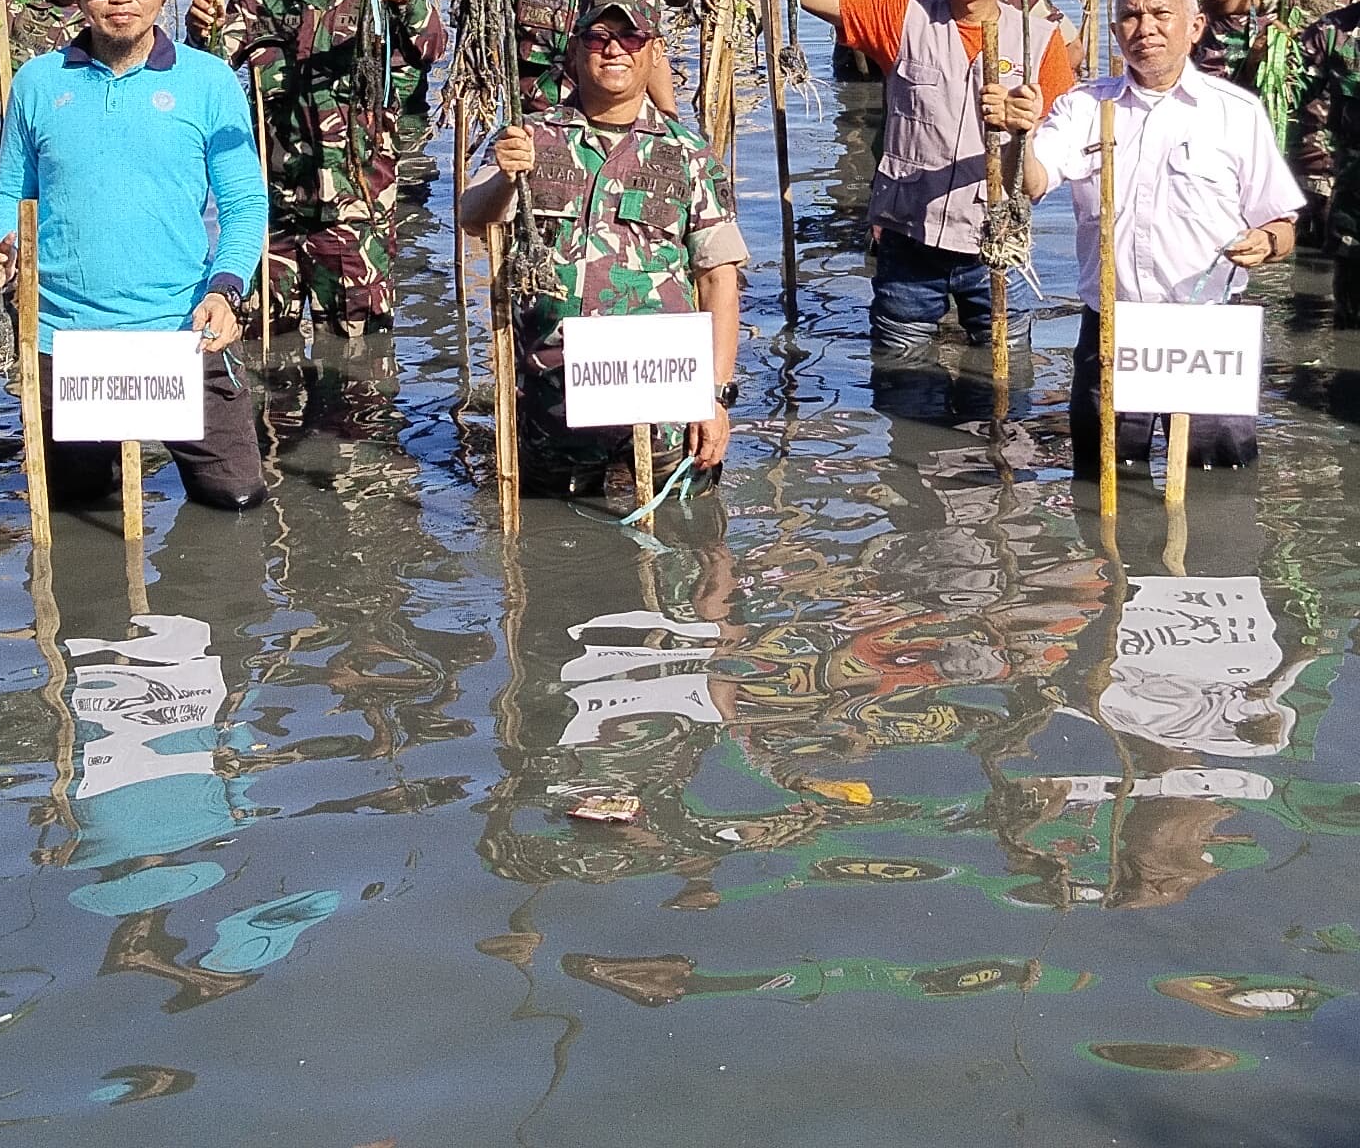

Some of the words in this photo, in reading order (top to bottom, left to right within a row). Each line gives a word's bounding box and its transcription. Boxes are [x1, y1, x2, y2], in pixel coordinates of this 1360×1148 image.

[534, 164, 576, 181] AJAR
[571, 360, 629, 387] DANDIM
[632, 357, 697, 384] 1421/PKP
[1116, 346, 1244, 375] BUPATI
[59, 376, 90, 401] DIRUT
[91, 376, 105, 400] PT
[106, 375, 142, 401] SEMEN
[143, 375, 186, 401] TONASA
